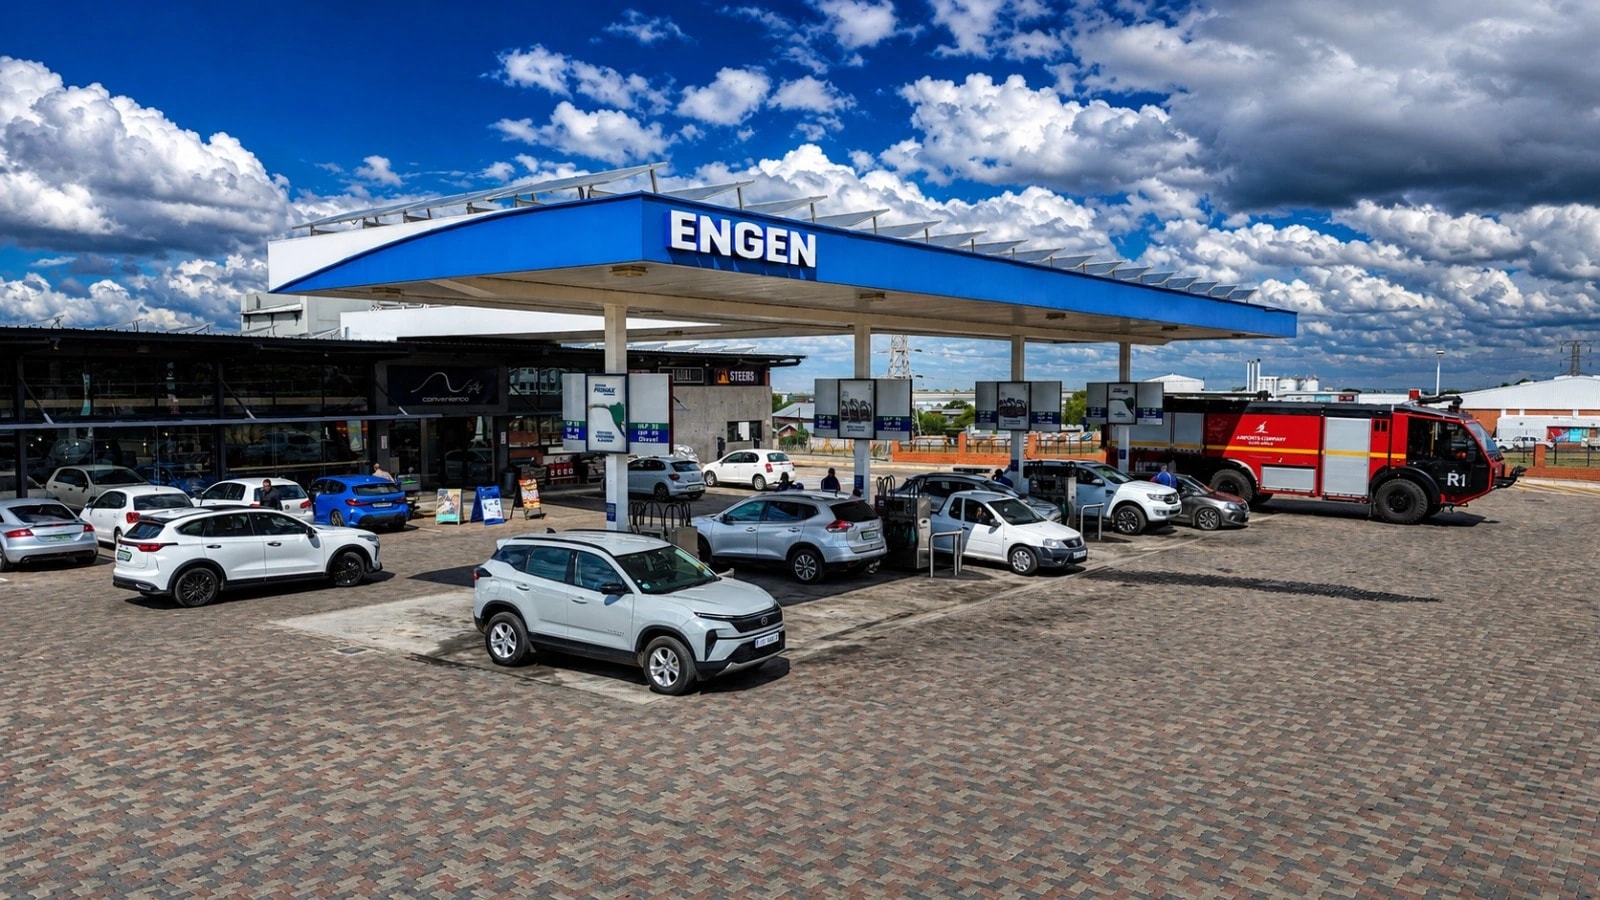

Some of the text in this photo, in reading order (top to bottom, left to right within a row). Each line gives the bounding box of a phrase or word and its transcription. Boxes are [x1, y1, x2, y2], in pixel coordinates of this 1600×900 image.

[670, 209, 817, 268] ENGEN
[729, 370, 755, 382] STEERS
[1447, 473, 1466, 487] R1
